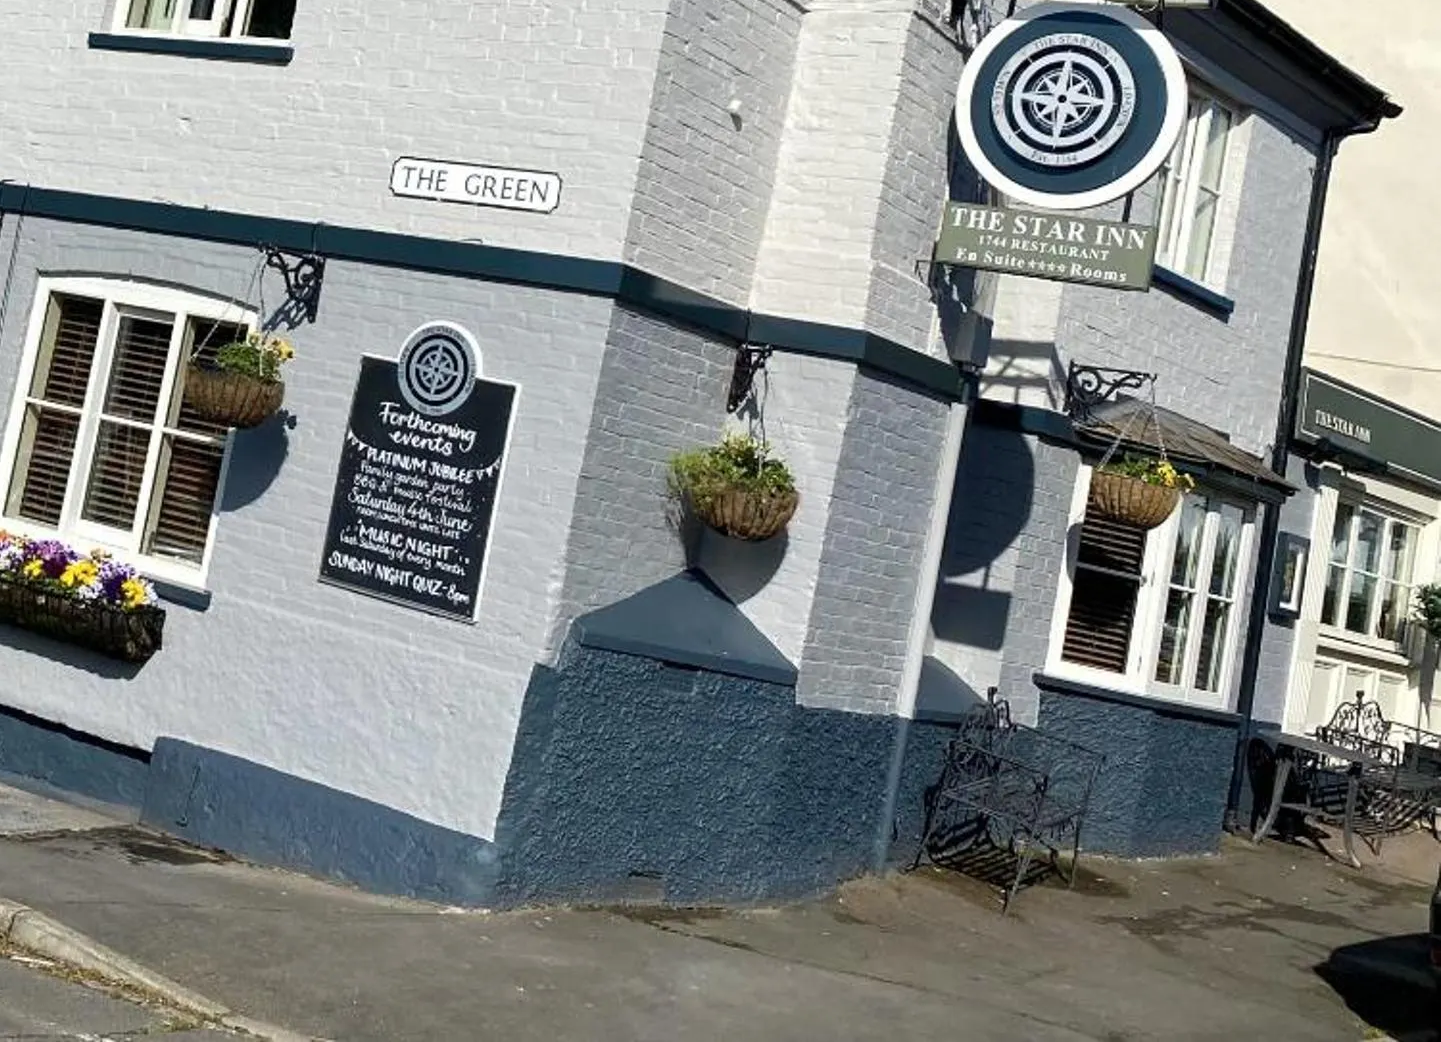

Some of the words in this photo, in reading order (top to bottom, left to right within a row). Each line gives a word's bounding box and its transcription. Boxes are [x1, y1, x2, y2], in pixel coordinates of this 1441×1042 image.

[401, 165, 449, 193] THE
[464, 173, 550, 204] GREEN
[951, 207, 1005, 233] THE
[1012, 214, 1086, 243] STAR
[1095, 224, 1149, 250] INN
[956, 247, 978, 262] En
[984, 249, 1026, 269] Suite
[1070, 262, 1128, 283] Rooms
[1011, 236, 1110, 262] RESTAURANT
[378, 401, 477, 453] Forthcoming
[388, 430, 452, 456] events
[366, 445, 427, 471] PLATINUM
[428, 461, 474, 484] JUBILEE
[347, 486, 406, 517] Saturday
[434, 507, 473, 532] June
[359, 524, 403, 547] MUSIC
[404, 536, 454, 560] NIGHT
[327, 549, 375, 575] SUNDAY
[374, 563, 414, 587] NIGHT
